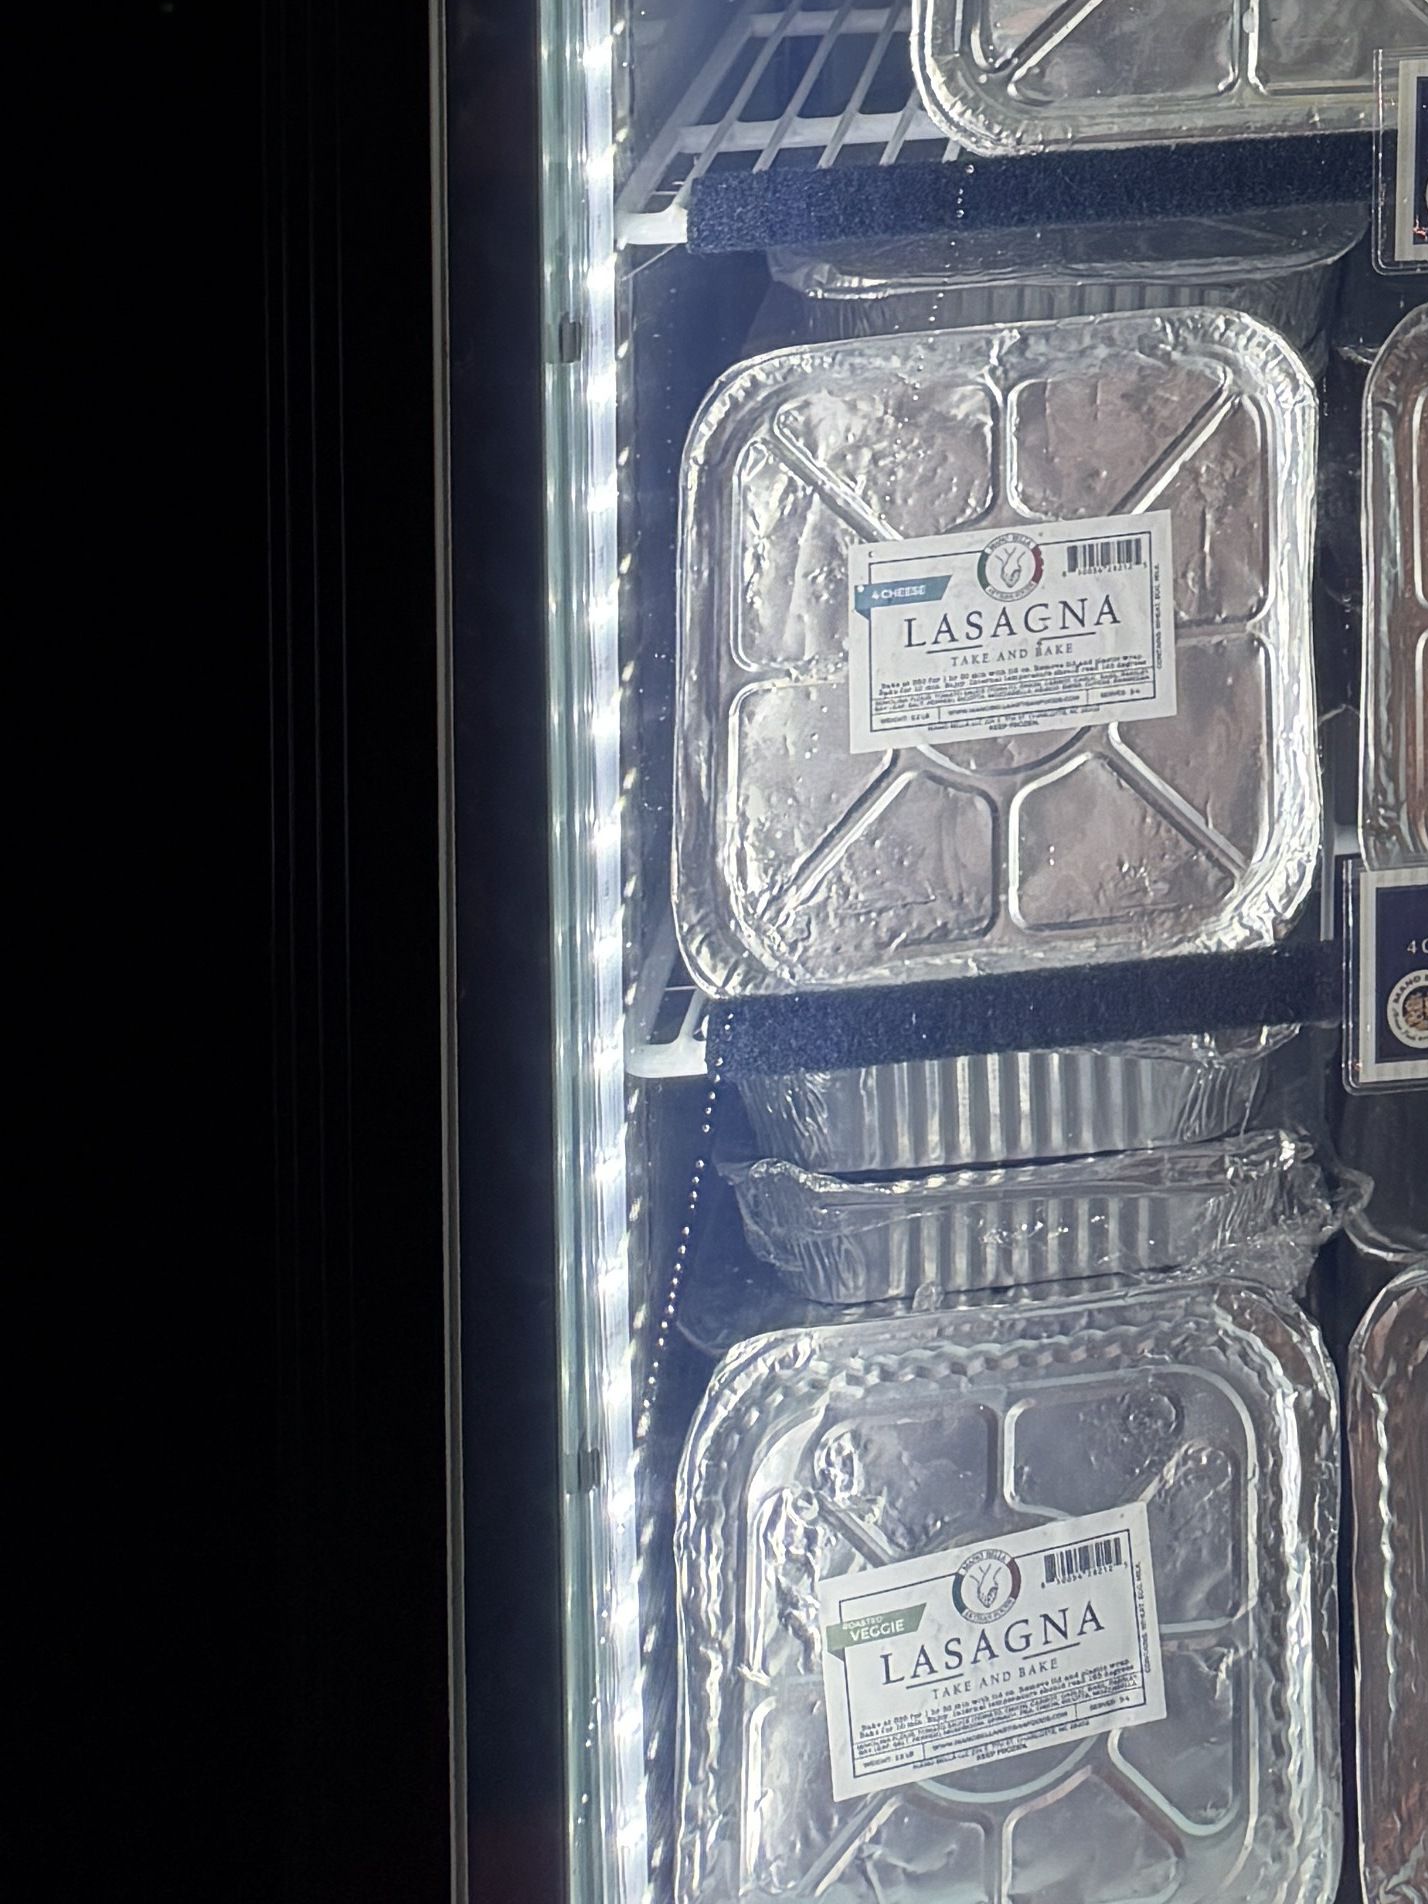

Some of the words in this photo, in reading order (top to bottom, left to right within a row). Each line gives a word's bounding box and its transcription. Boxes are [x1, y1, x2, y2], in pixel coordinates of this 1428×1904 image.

[882, 585, 926, 599] CHEESE
[904, 594, 1121, 648] LASAGNA
[951, 653, 990, 667] TAKE
[996, 648, 1029, 662] AND
[1035, 643, 1073, 657] BAKE
[1406, 940, 1418, 954] 4
[849, 1618, 905, 1642] VEGGIE
[880, 1600, 1105, 1687] LASAGNA
[932, 1681, 972, 1700] TAKE
[979, 1670, 1012, 1691] AND
[1018, 1658, 1060, 1679] BAKE
